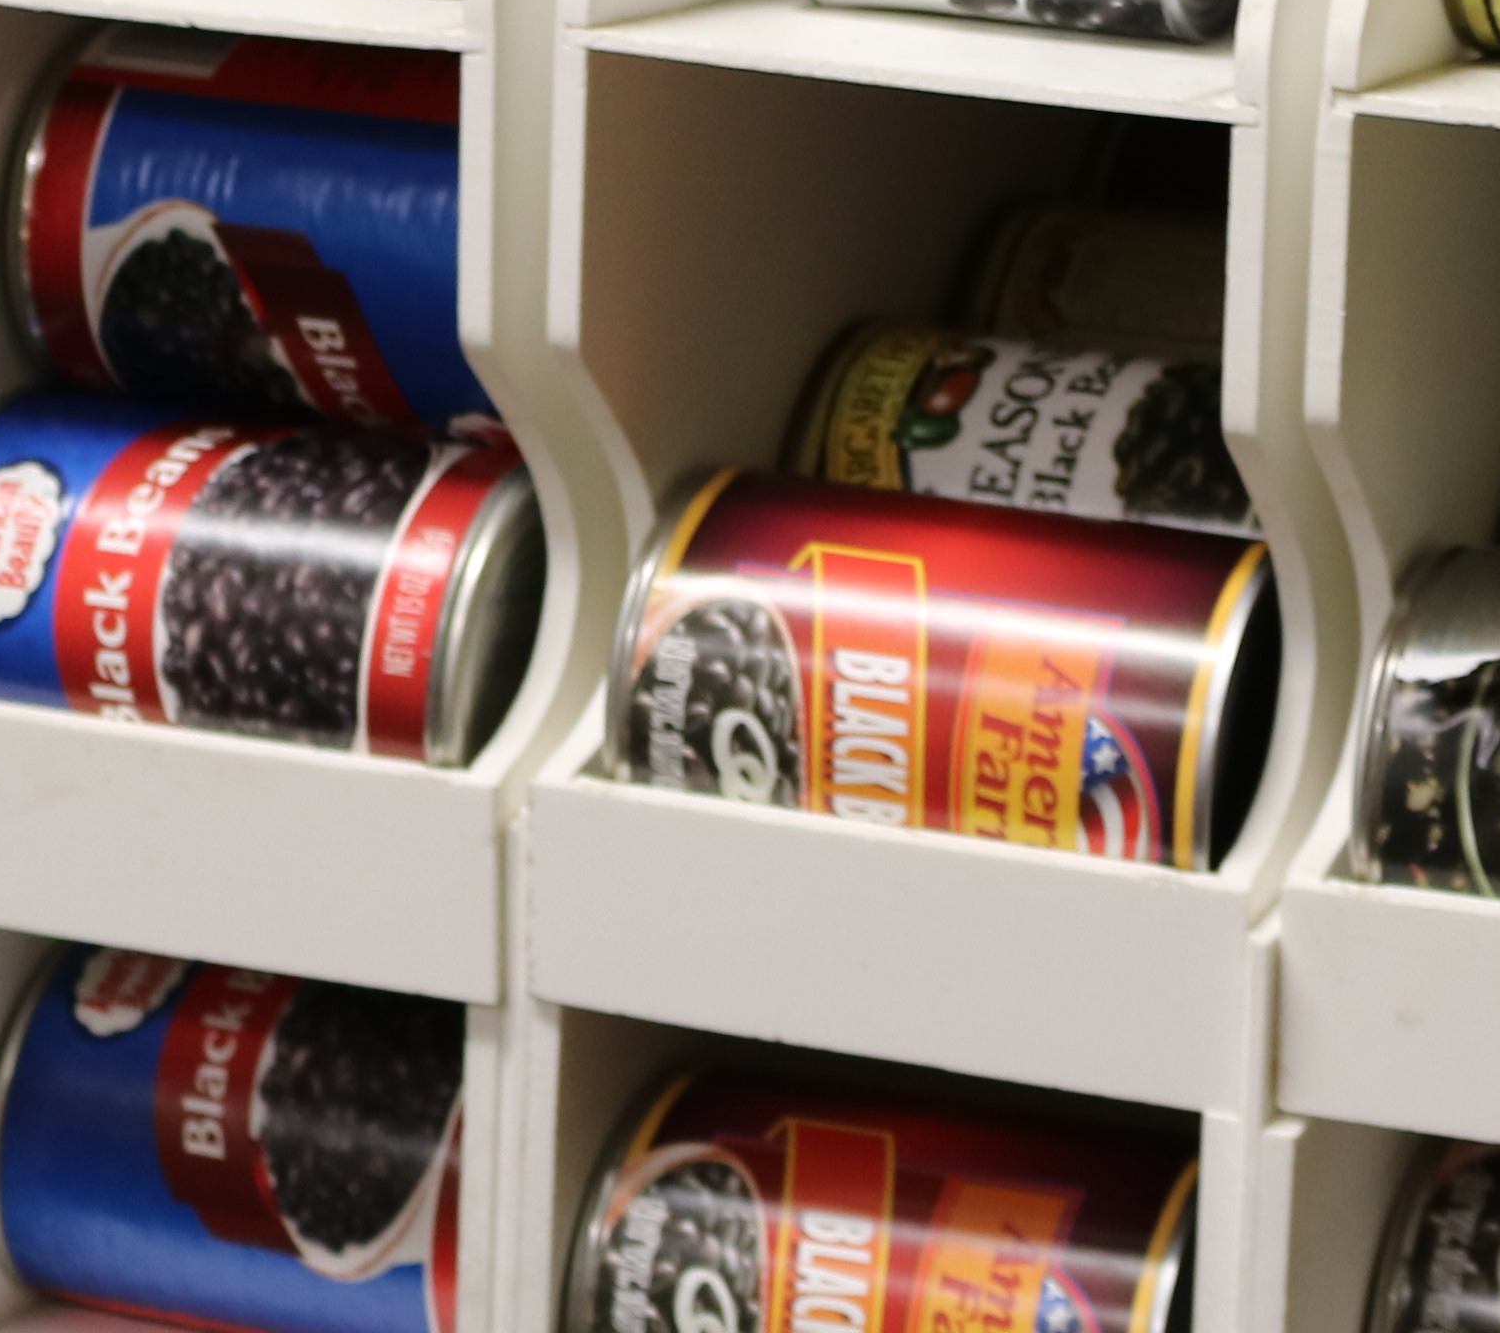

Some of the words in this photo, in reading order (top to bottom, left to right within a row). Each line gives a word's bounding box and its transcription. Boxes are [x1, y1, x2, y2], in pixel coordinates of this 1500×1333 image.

[86, 569, 144, 724] Black
[832, 646, 911, 801] BLACK
[182, 1005, 250, 1161] Black
